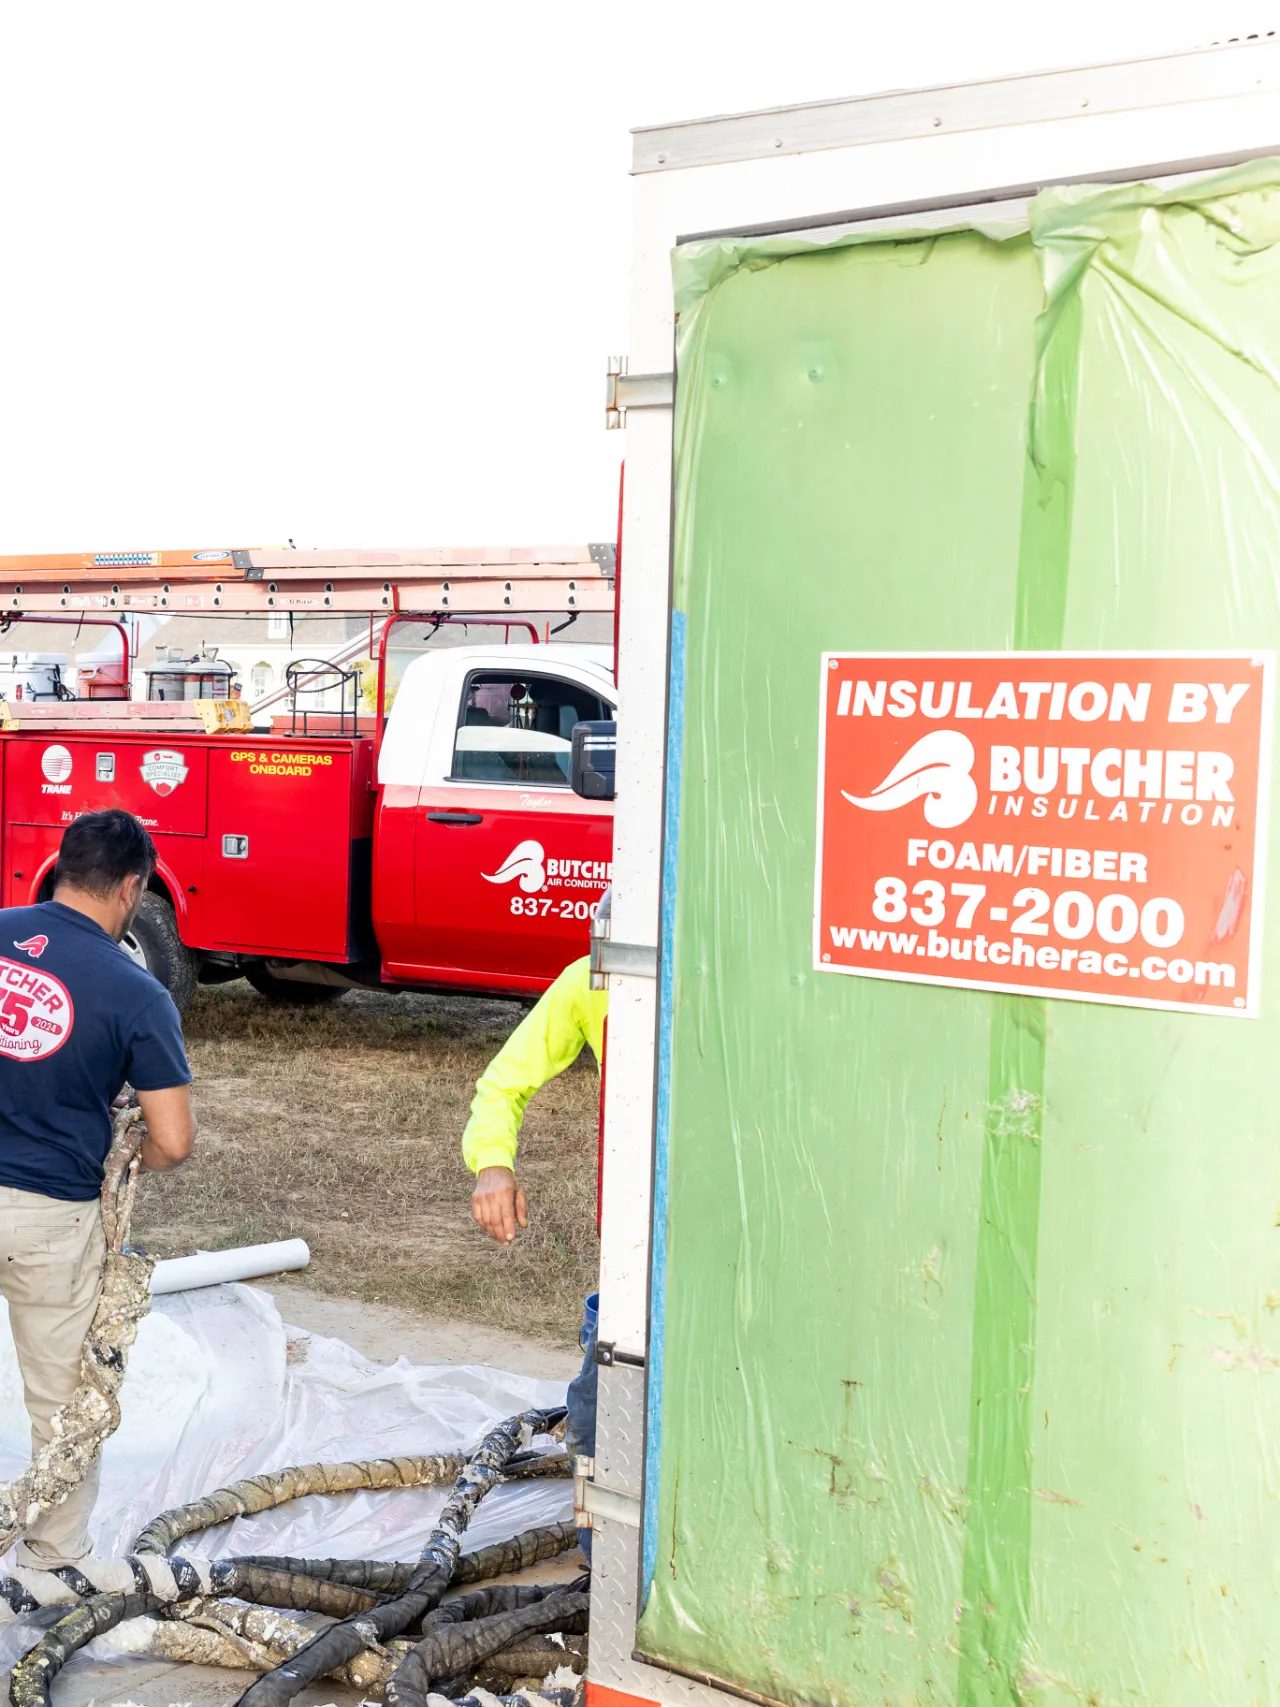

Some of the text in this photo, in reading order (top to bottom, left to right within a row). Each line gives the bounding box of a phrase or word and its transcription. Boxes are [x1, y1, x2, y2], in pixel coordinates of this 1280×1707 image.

[836, 680, 1250, 724] INSULATION BY
[230, 752, 333, 766] GPS & CAMERAS
[146, 770, 181, 779] SPECIALIST
[148, 764, 179, 772] COMFORT
[249, 764, 312, 776] ONBOARD
[989, 745, 1235, 802] BUTCHER
[41, 784, 73, 795] TRANE
[519, 793, 553, 808] Taylor
[61, 811, 74, 821] It's
[988, 795, 1235, 827] INSULATION
[907, 838, 1148, 883] FOAM/FIBER
[547, 878, 562, 886] AIR
[871, 876, 1185, 948] 837-2000
[829, 925, 1237, 988] www.butcherac.com
[1, 1022, 20, 1036] Years
[35, 1018, 57, 1033] 2024
